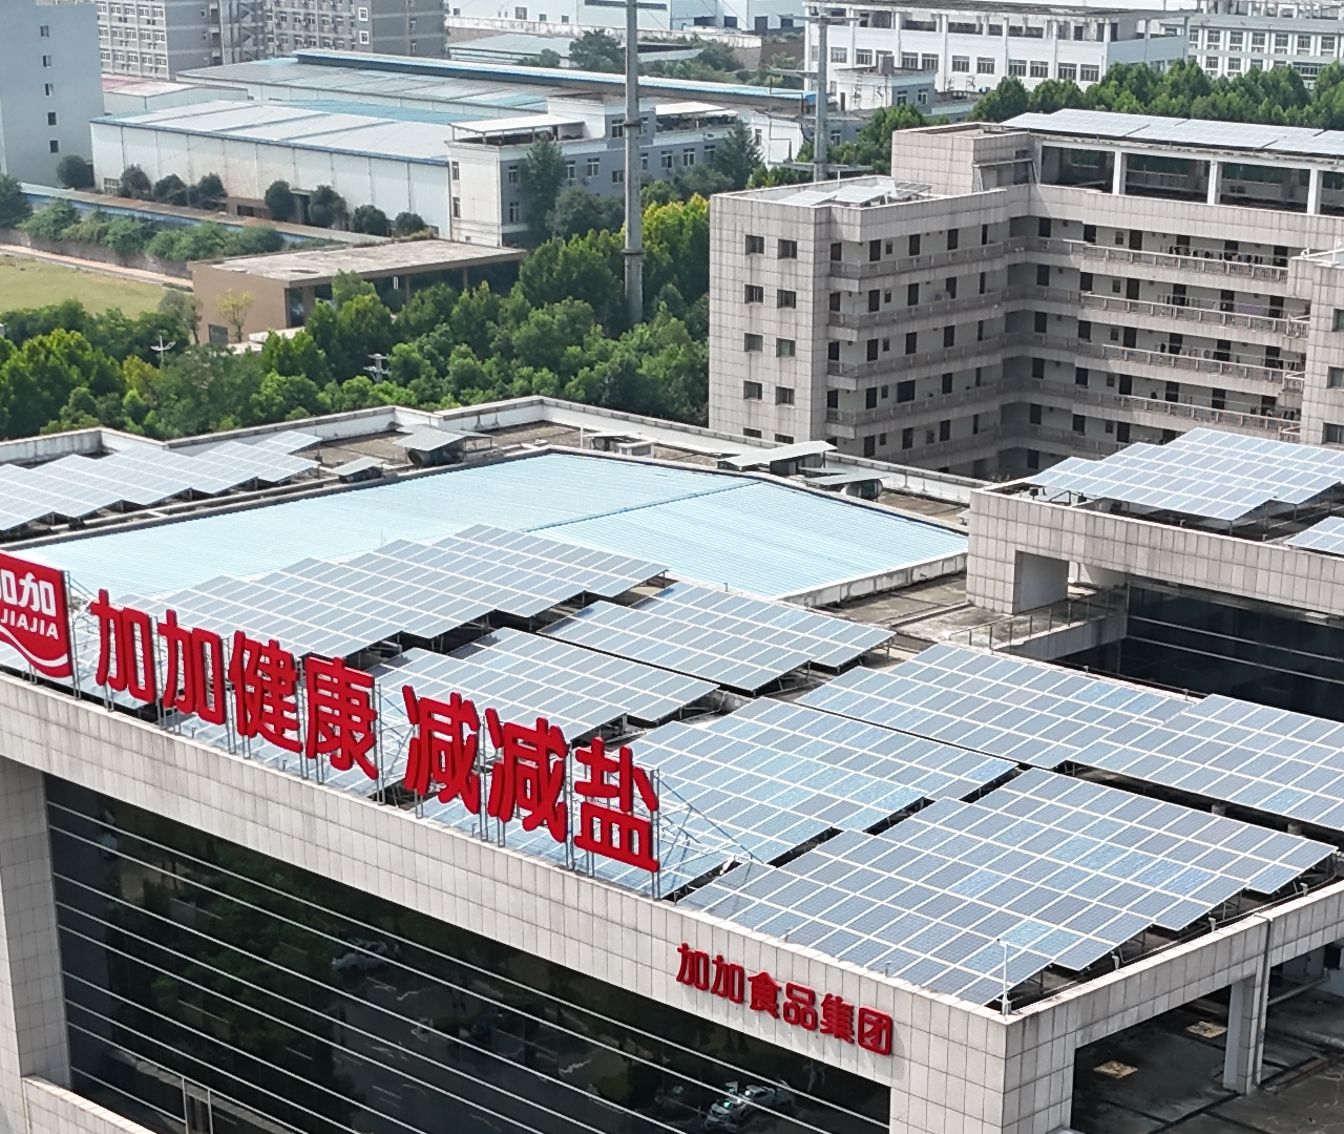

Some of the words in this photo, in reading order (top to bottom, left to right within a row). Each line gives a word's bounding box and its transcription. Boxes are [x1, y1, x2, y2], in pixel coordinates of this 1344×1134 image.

[1, 609, 58, 639] JIAJIA
[89, 589, 379, 780] 加加健康
[403, 686, 660, 873] 减减盐
[677, 943, 893, 1056] 加加食品集团
